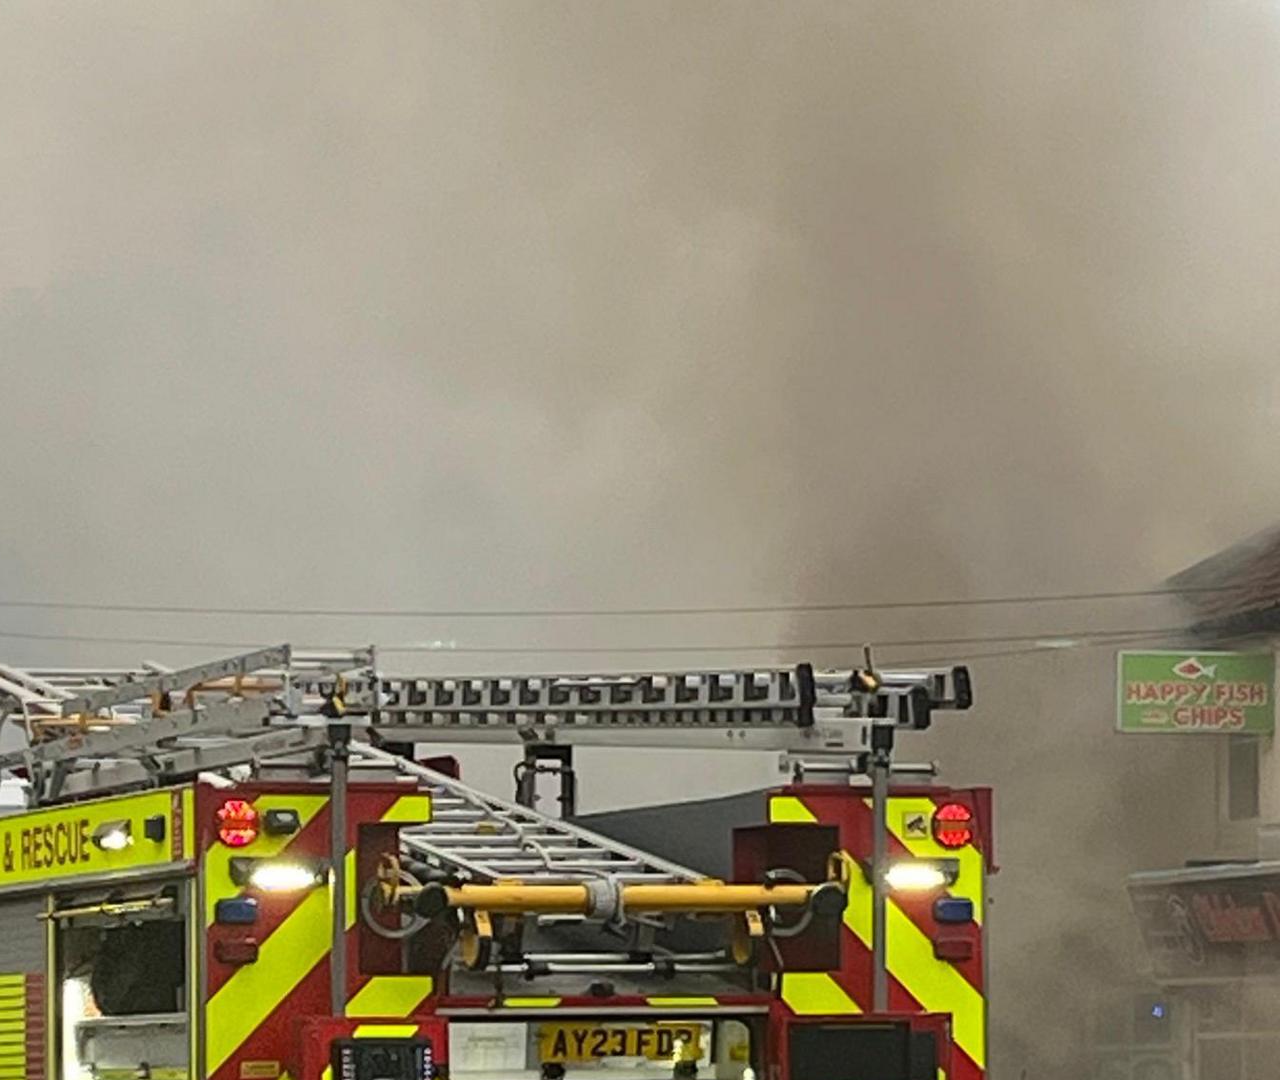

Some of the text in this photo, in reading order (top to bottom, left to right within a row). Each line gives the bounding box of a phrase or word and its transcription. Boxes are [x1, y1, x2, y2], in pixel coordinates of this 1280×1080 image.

[1126, 683, 1266, 704] HAPPY FISH
[1173, 706, 1245, 728] CHIPS
[4, 831, 15, 872] &
[21, 819, 90, 871] RESCUE
[552, 1027, 627, 1057] AY23
